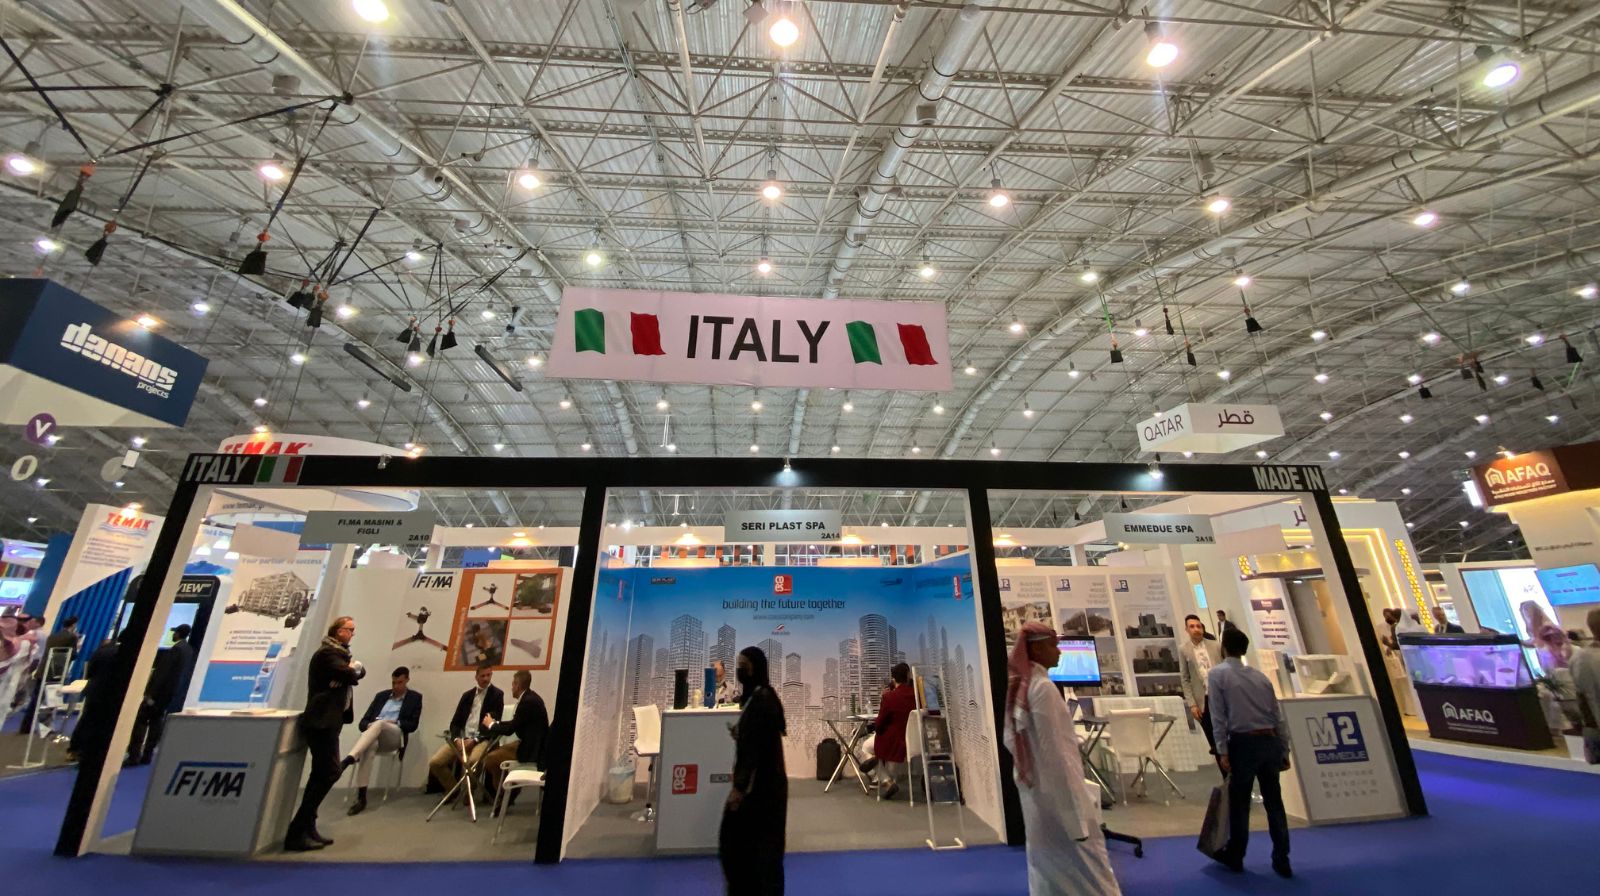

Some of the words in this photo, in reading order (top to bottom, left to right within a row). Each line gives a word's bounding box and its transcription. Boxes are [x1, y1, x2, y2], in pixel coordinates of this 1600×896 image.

[686, 314, 831, 364] ITALY
[1143, 414, 1184, 442] QATAR
[1217, 409, 1254, 428] قطر
[185, 455, 252, 482] ITALY
[1506, 462, 1551, 484] AFAQ
[1252, 466, 1303, 491] MADE
[1304, 466, 1325, 491] IN
[105, 512, 152, 531] TEMAK
[741, 522, 766, 530] SERI
[769, 522, 803, 530] PLAST
[805, 521, 826, 530] SPA
[1124, 524, 1173, 533] EMMEDUE
[1175, 525, 1194, 533] SPA
[722, 599, 759, 611] building
[760, 599, 776, 609] the
[778, 599, 805, 609] future
[807, 599, 847, 611] together
[1459, 708, 1495, 723] AFAQ
[1305, 715, 1359, 747] M2
[1317, 751, 1368, 761] EMMEDUE
